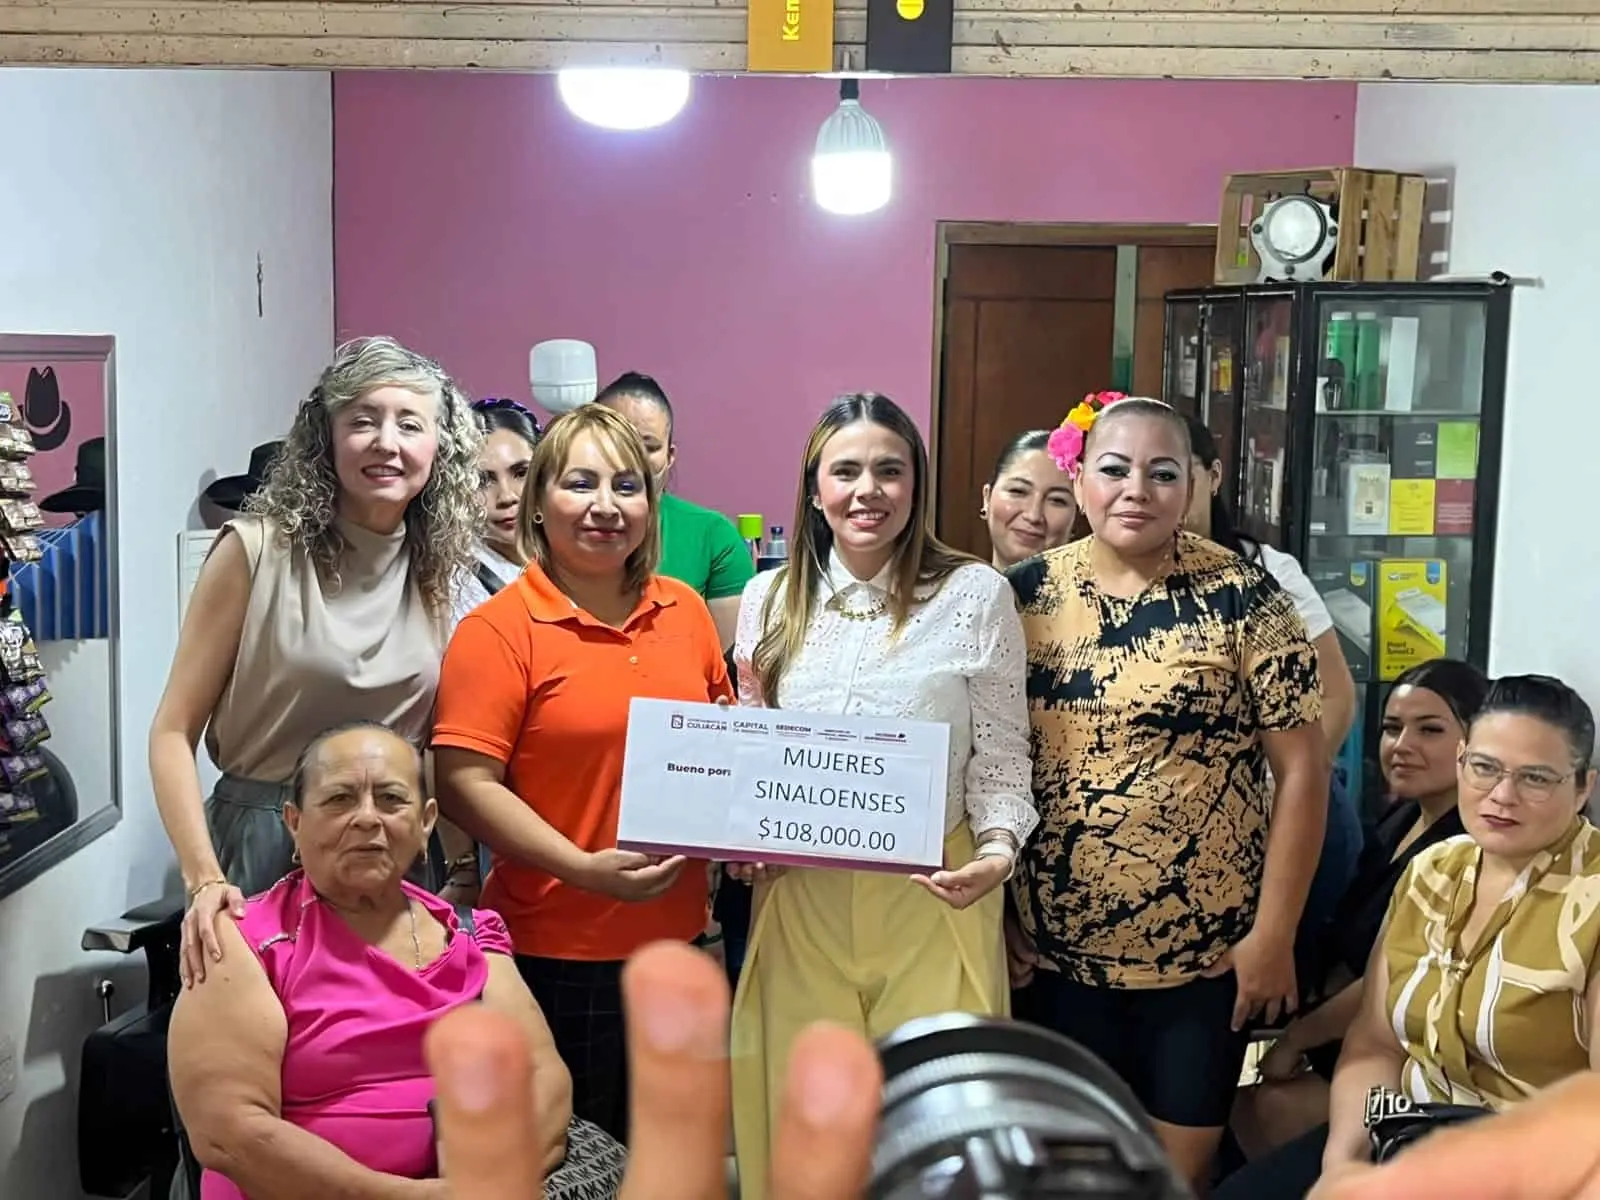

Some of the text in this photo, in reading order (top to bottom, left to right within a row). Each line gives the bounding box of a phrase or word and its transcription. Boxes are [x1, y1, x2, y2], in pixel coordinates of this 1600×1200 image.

[667, 762, 732, 777] Bueno por:
[783, 747, 886, 776] MUJERES
[754, 780, 906, 814] SINALOENSES
[758, 816, 896, 852] $108,000.00
